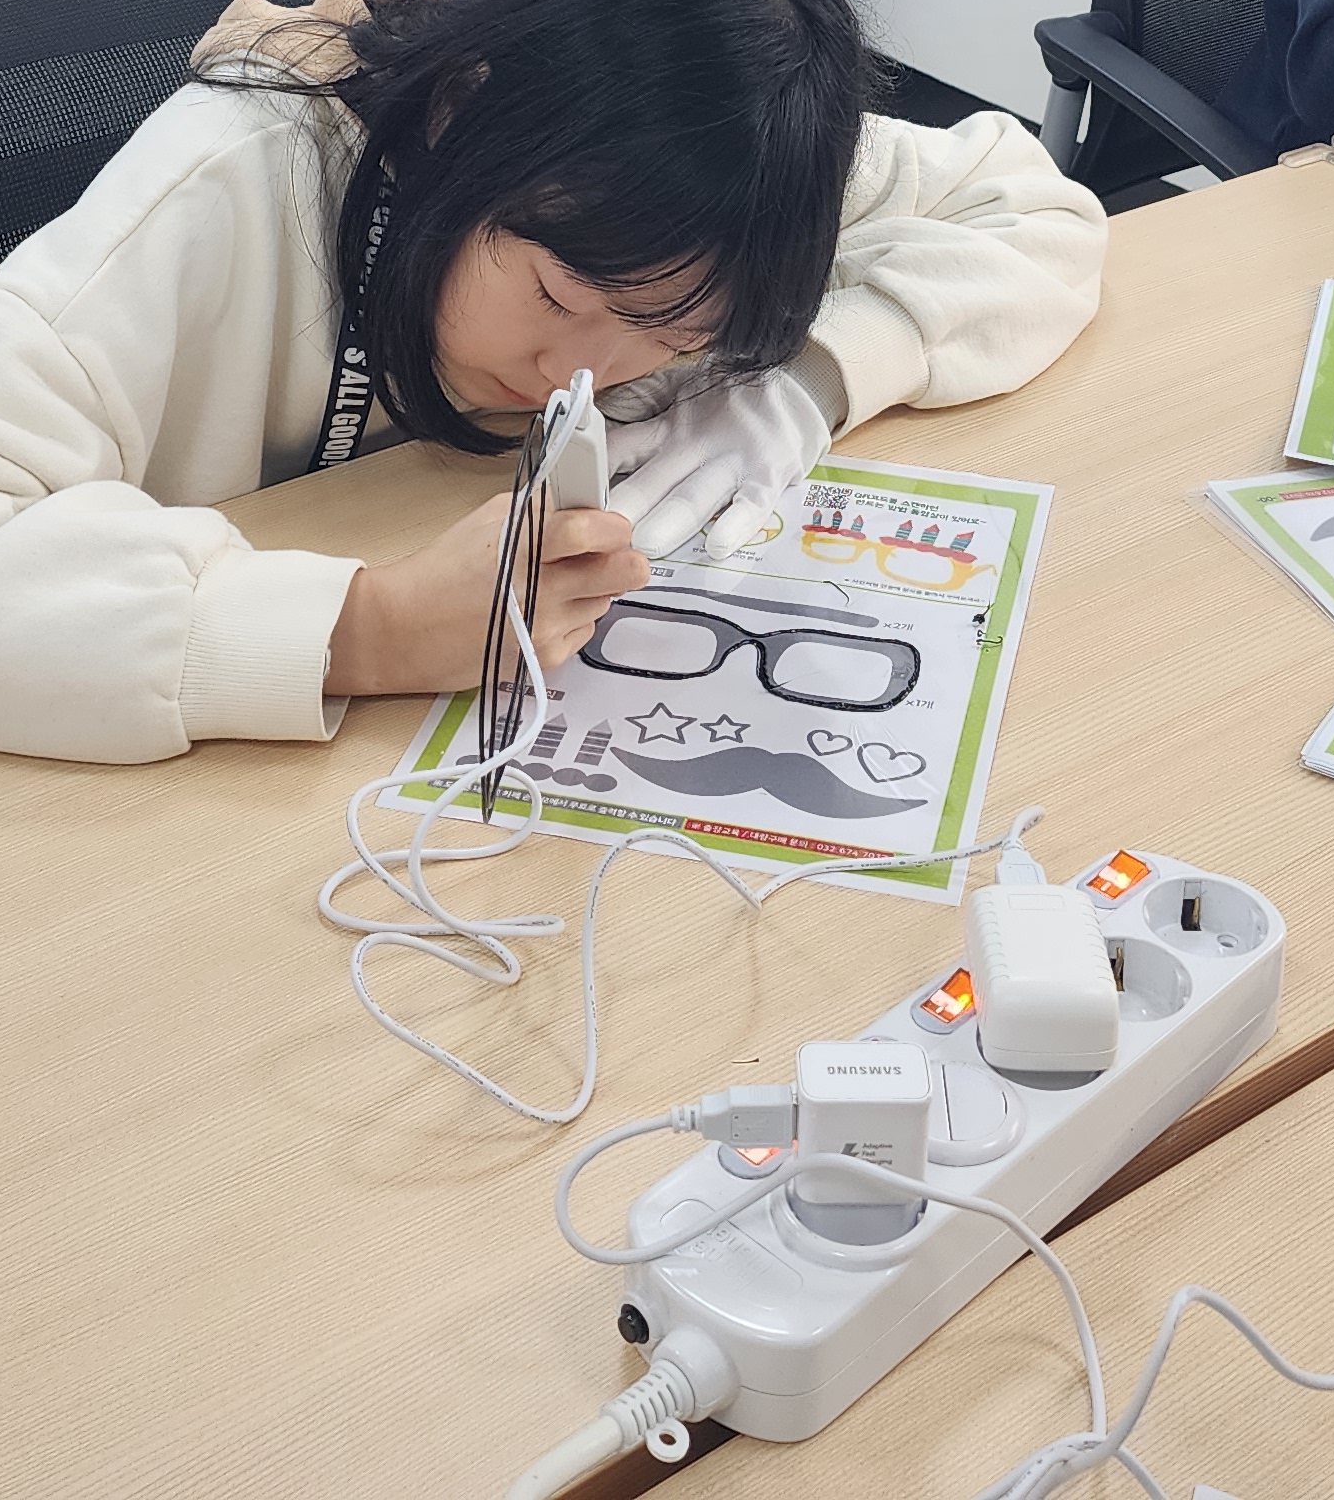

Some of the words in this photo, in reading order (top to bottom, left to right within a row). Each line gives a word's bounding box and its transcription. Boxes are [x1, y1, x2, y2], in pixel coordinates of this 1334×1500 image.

[335, 367, 370, 409] ALL
[318, 411, 362, 468] GOOD!
[815, 842, 836, 853] 032
[827, 1066, 902, 1075] SAMSUNG
